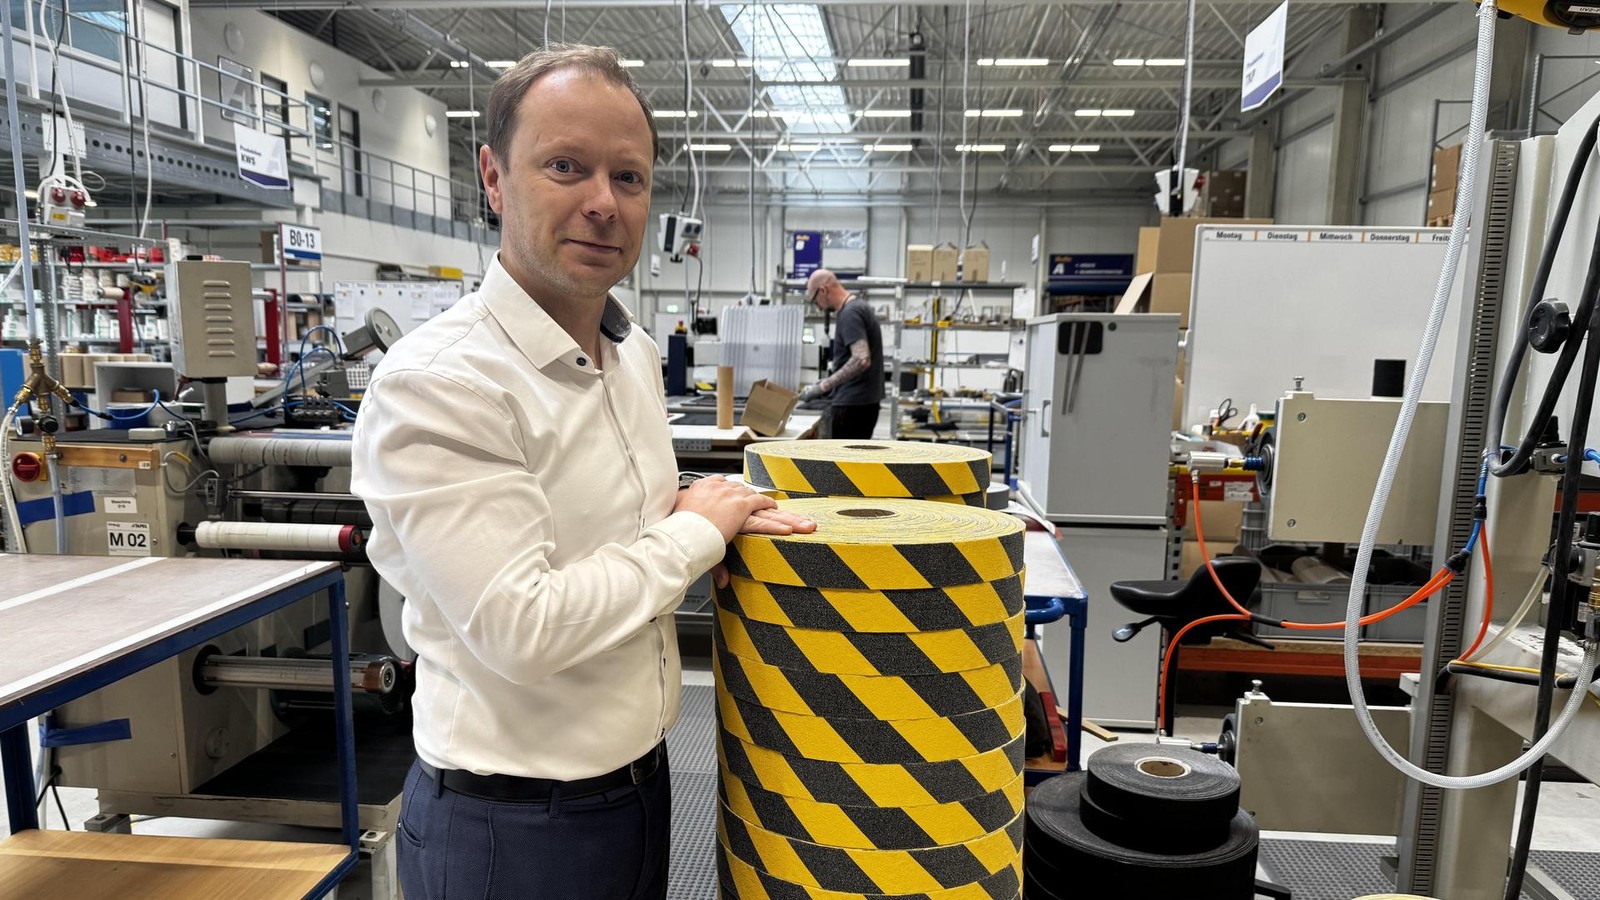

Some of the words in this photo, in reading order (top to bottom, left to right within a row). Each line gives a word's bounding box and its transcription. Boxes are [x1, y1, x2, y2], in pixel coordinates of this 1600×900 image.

[1216, 231, 1242, 241] Montag
[1267, 232, 1298, 242] Dienstag
[1319, 233, 1353, 241] Mittwoch
[1370, 233, 1410, 243] Donnerstag
[1431, 233, 1450, 242] Freit
[1052, 262, 1064, 275] A
[109, 532, 124, 546] M
[127, 533, 147, 548] 02
